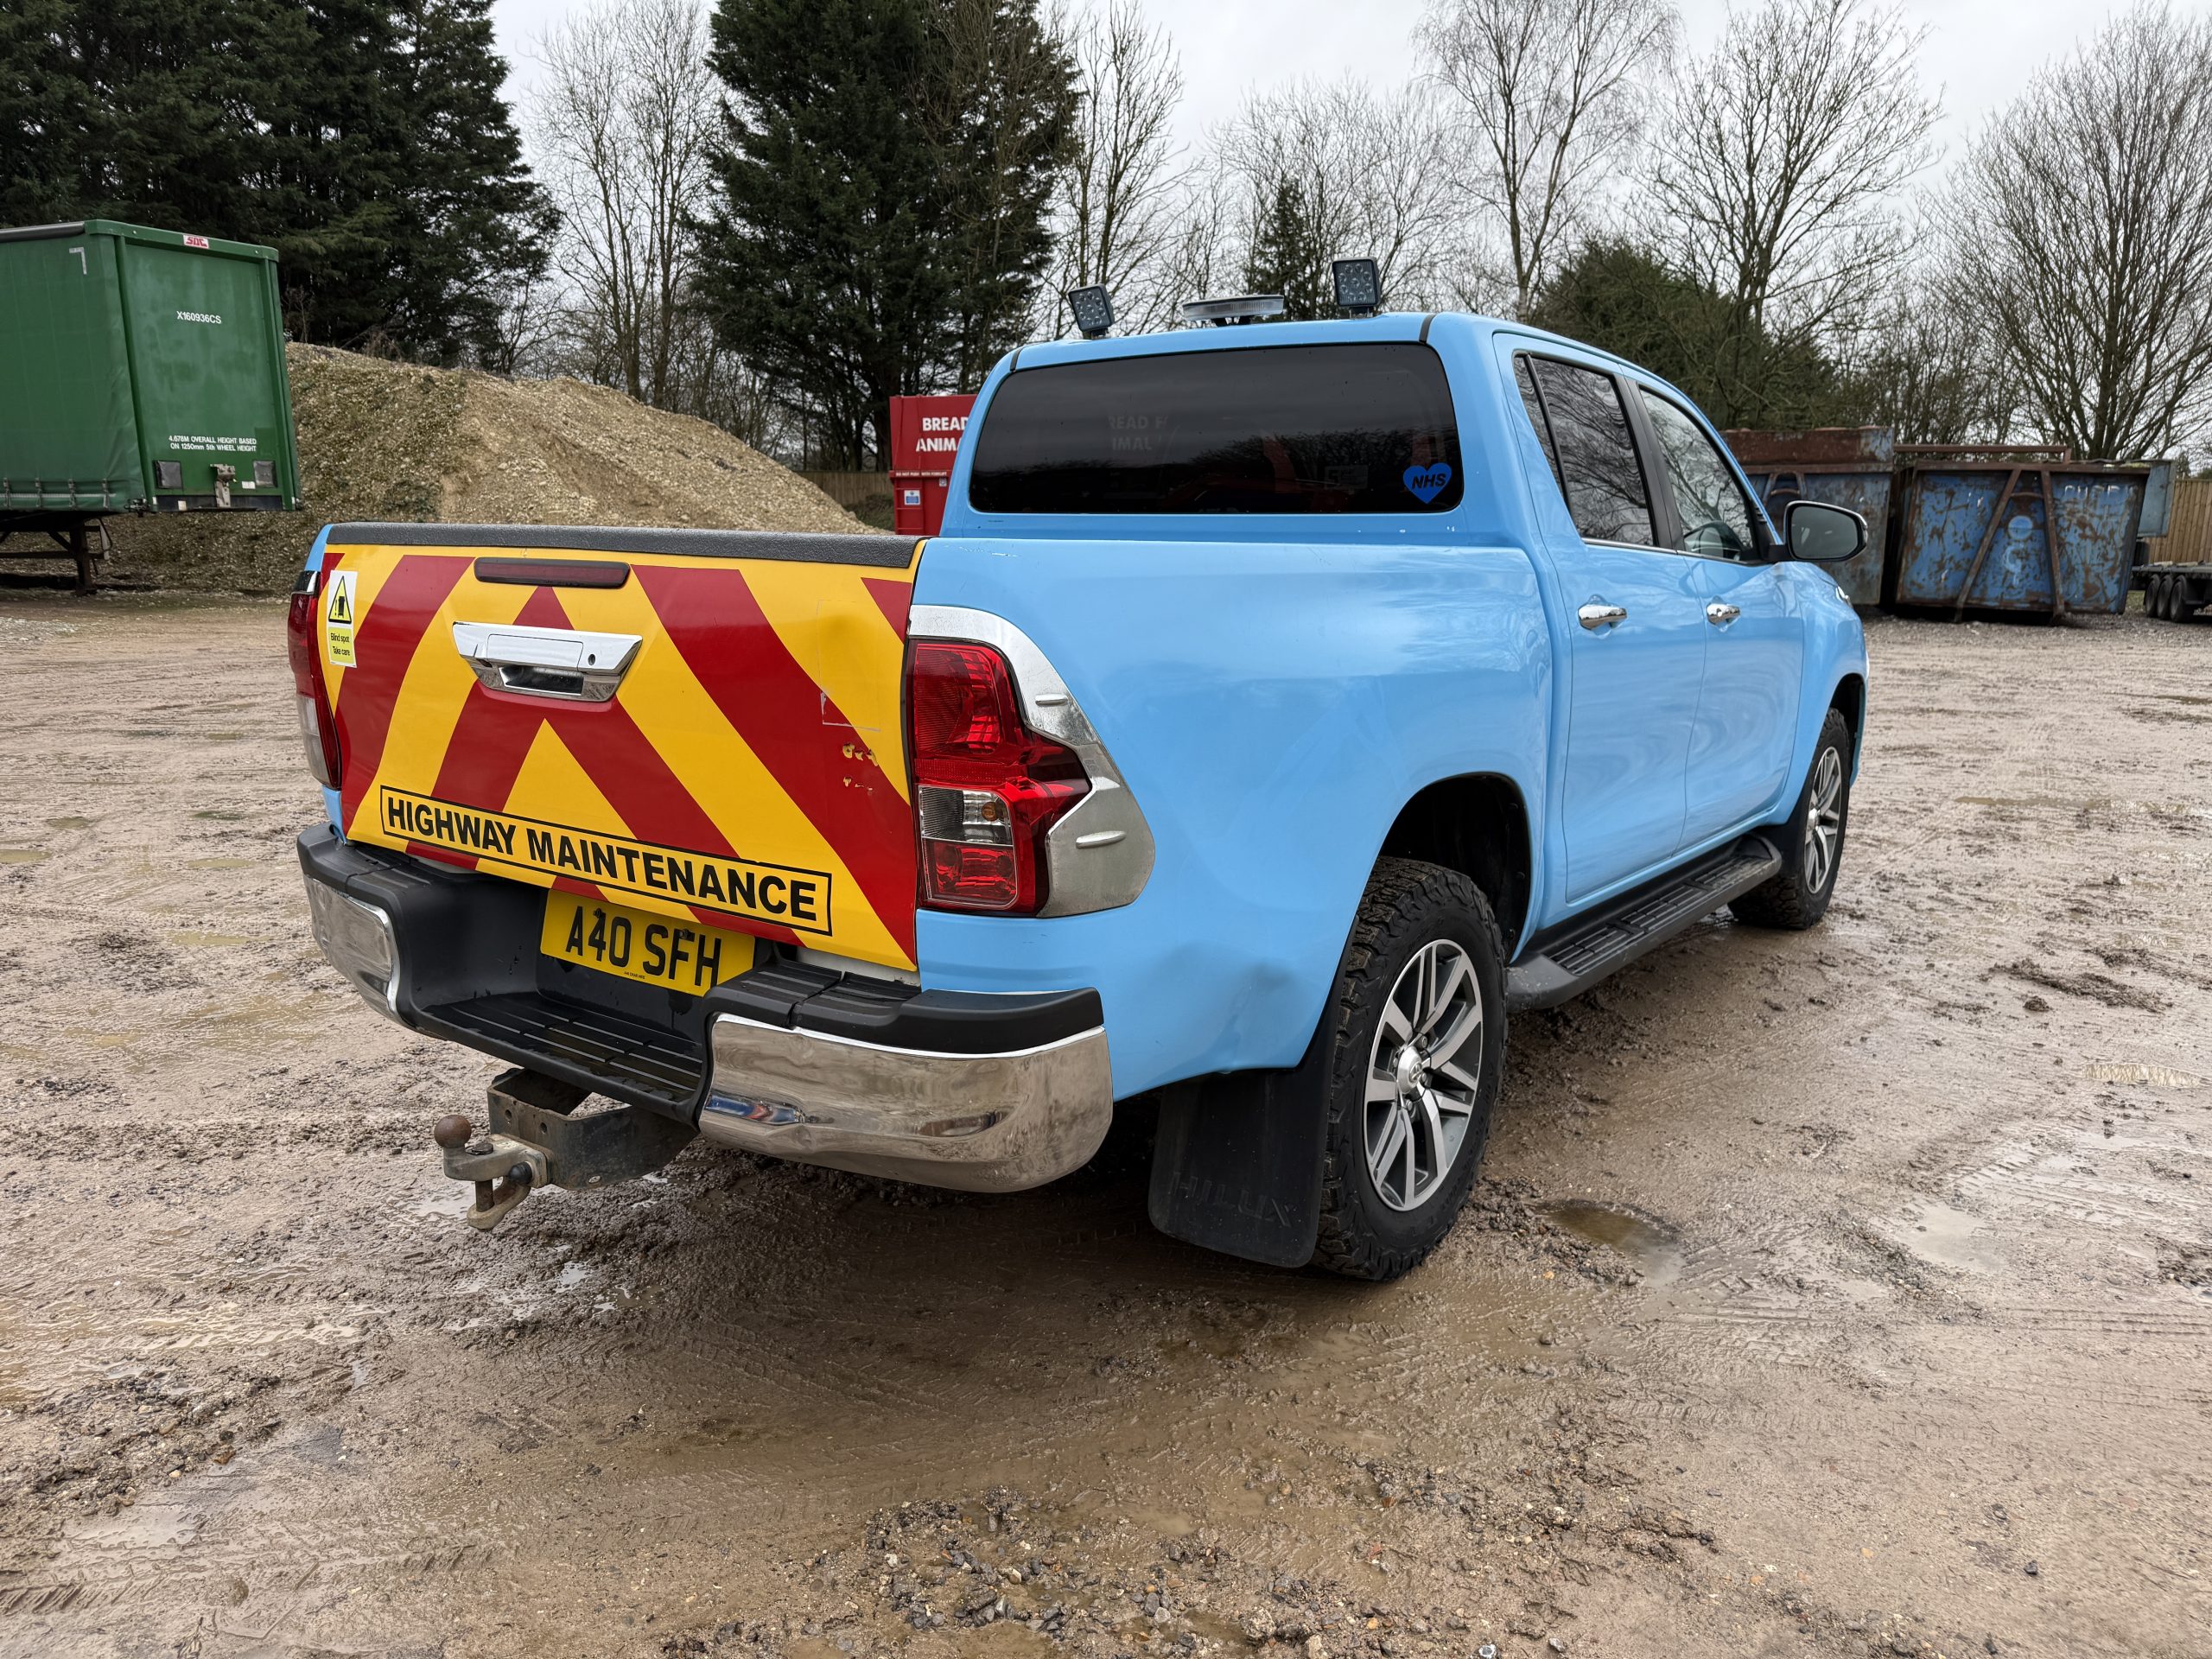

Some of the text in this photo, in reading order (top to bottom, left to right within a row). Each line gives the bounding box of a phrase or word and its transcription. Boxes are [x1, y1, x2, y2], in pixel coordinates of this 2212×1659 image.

[177, 311, 221, 324] X160936CS
[916, 437, 962, 452] ANIM
[1412, 474, 1446, 489] NHS
[331, 633, 350, 644] Blind spot
[333, 646, 341, 655] Take
[388, 797, 817, 921] HIGHWAY MAINTENANCE
[565, 906, 721, 988] A40 SFH
